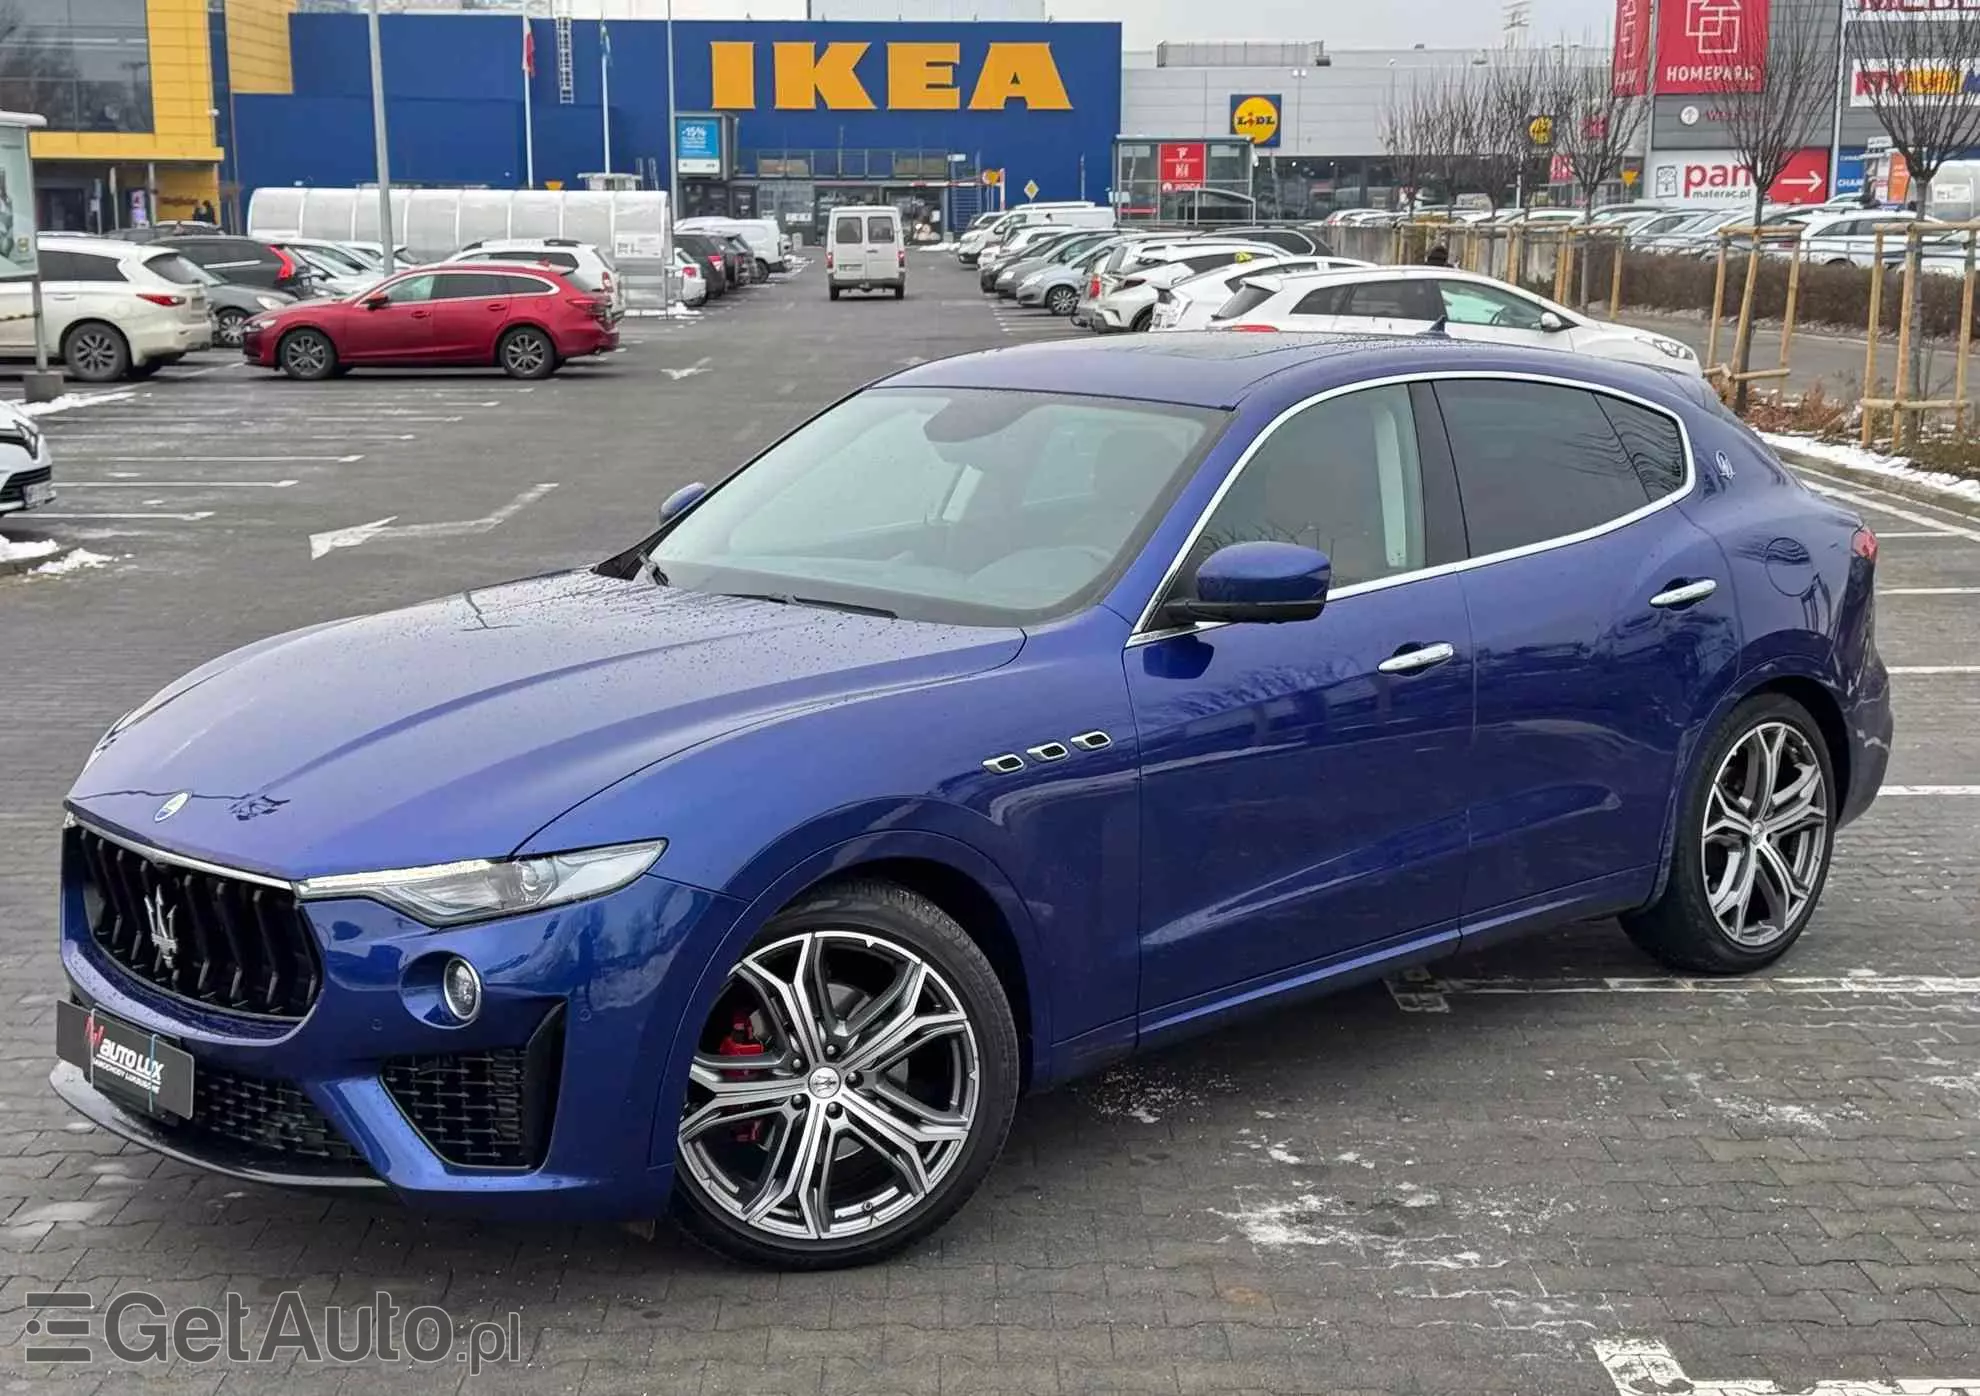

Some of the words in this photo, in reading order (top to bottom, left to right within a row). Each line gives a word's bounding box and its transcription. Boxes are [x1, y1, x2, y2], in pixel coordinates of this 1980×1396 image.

[710, 41, 1073, 110] IKEA
[1666, 65, 1755, 82] HOMEPARK
[1237, 112, 1276, 128] LIDL
[1683, 164, 1751, 198] pan
[1692, 189, 1751, 199] materac.pl
